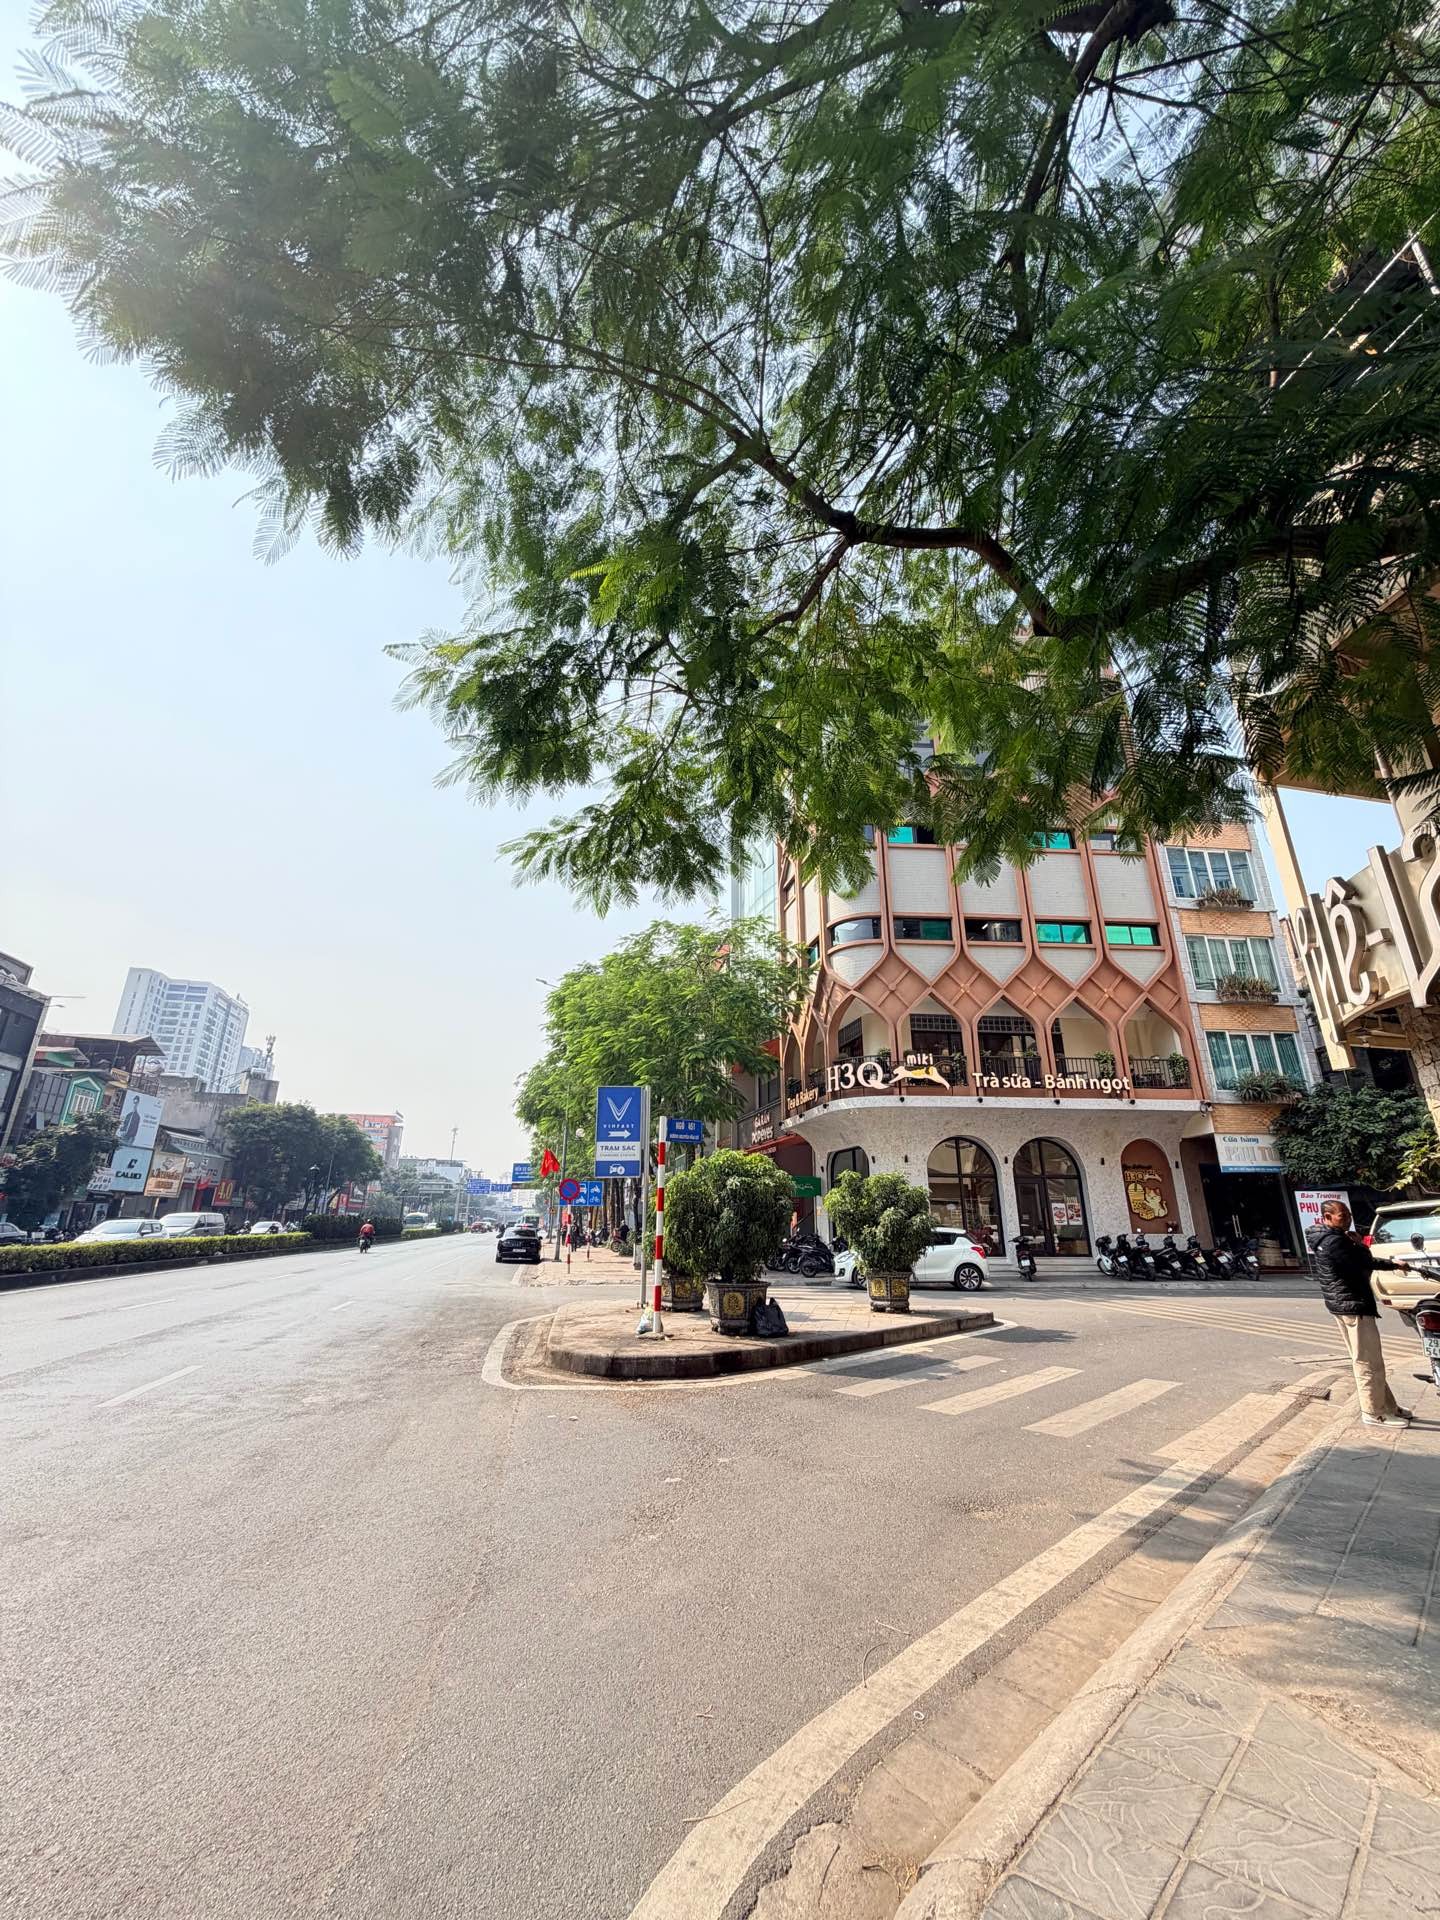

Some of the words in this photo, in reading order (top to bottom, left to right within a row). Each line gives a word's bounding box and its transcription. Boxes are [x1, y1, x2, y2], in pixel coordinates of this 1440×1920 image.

[906, 1053, 934, 1065] miki
[826, 1061, 891, 1093] H3Q
[972, 1071, 1000, 1088] Trà
[1002, 1074, 1031, 1089] sữa
[1045, 1074, 1087, 1090] Bánh
[1090, 1076, 1131, 1094] ngọt
[787, 1097, 797, 1111] Tea
[800, 1087, 819, 1106] Bakery
[1299, 1201, 1319, 1216] PHỤ
